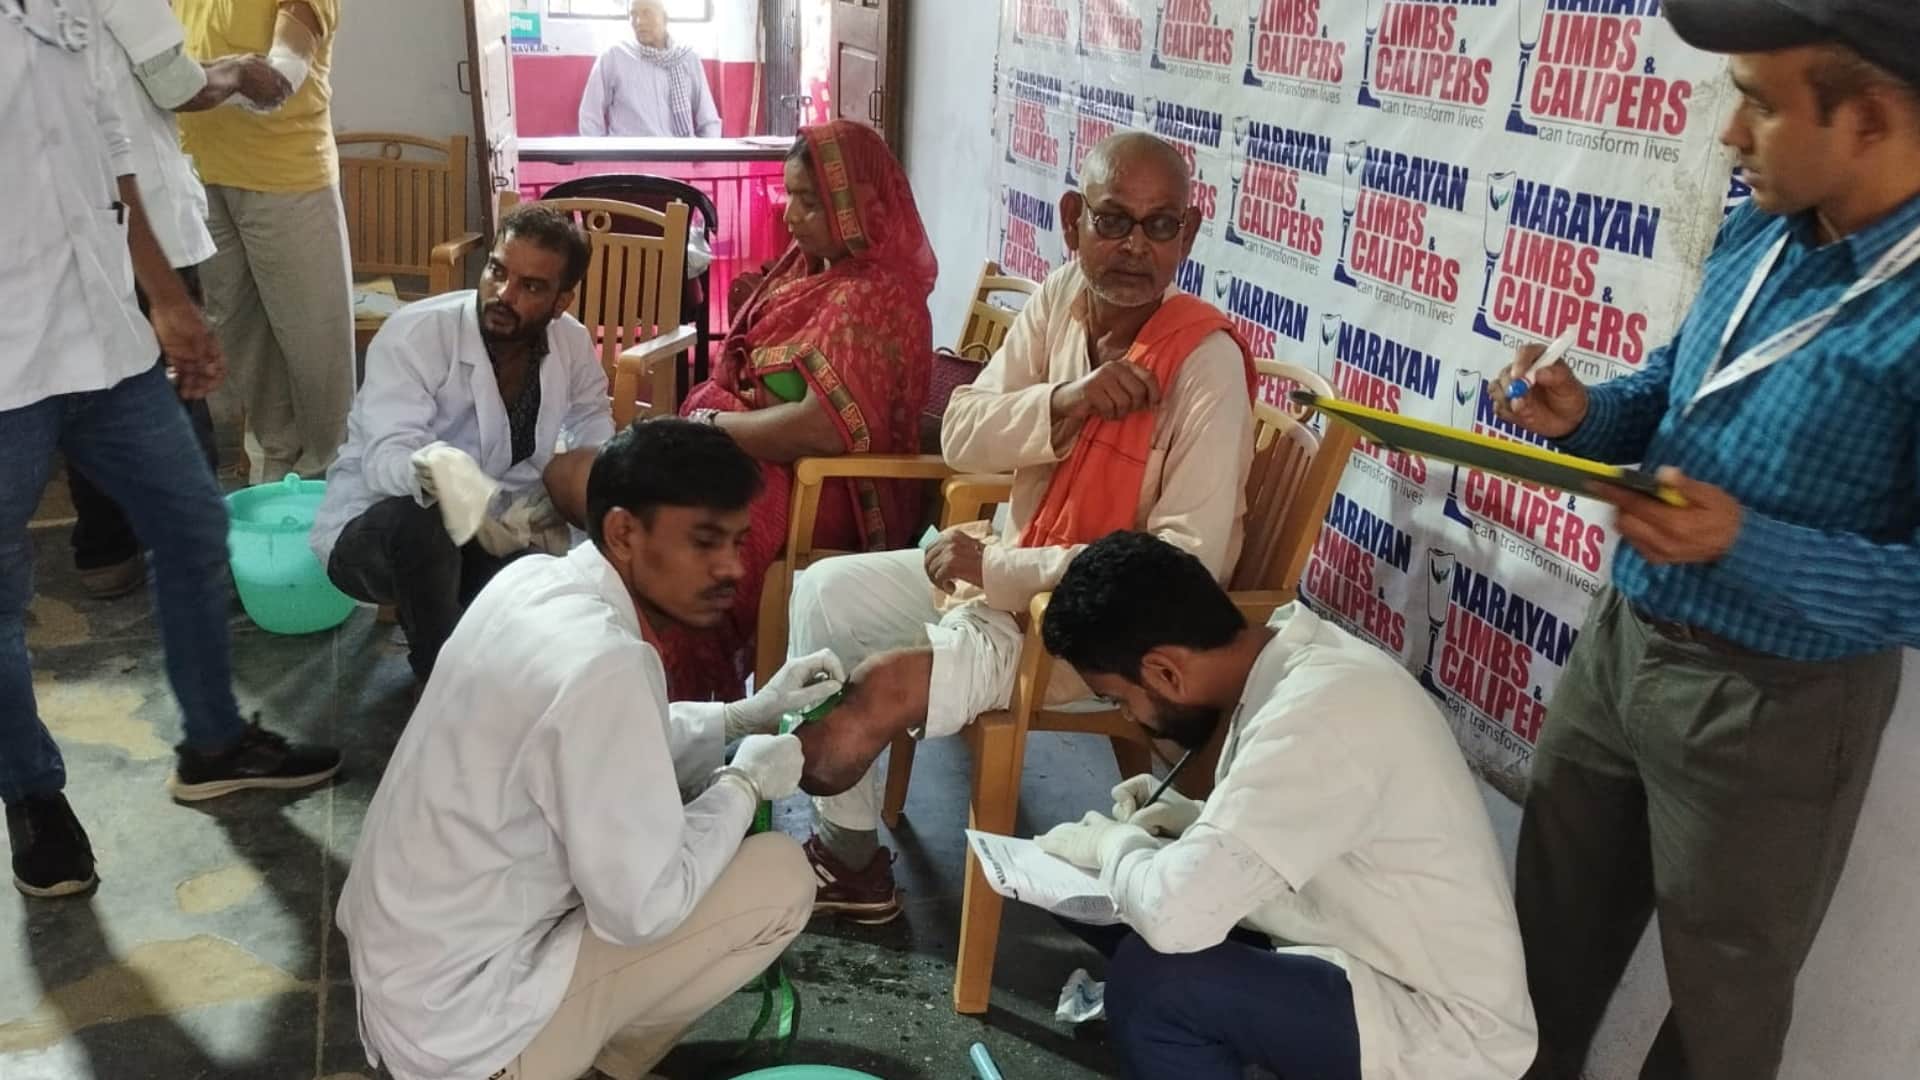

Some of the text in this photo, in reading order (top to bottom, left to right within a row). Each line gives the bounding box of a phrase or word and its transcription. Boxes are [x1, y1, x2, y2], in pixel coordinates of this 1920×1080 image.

[1162, 23, 1235, 65] CALIPERS
[1259, 0, 1320, 37] LIMBS
[1378, 2, 1457, 53] LIMBS
[1538, 13, 1655, 74] LIMBS &
[1257, 33, 1346, 83] CALIPERS
[1375, 47, 1492, 106] CALIPERS
[1381, 100, 1484, 129] can transform lives
[1530, 65, 1692, 136] CALIPERS
[1246, 121, 1331, 176] NARAYAN
[1538, 125, 1680, 164] can transform lives
[1242, 158, 1299, 209] LIMBS
[1361, 146, 1468, 212] NARAYAN
[1238, 196, 1325, 257] CALIPERS
[1355, 188, 1427, 247] LIMBS
[1510, 178, 1661, 259] NARAYAN
[1260, 242, 1299, 267] transform
[1300, 254, 1320, 276] lives
[1351, 230, 1460, 303] CALIPERS
[1502, 227, 1614, 304] LIMBS &
[1227, 276, 1308, 342] NARAYAN
[1356, 279, 1455, 325] can transform lives
[1493, 275, 1648, 365] CALIPERS
[1336, 321, 1440, 400] NARAYAN
[1400, 482, 1424, 505] lives
[1465, 468, 1605, 573] CALIPERS
[1473, 521, 1598, 595] can transform lives
[1306, 558, 1406, 653] CALIPERS
[1451, 561, 1579, 667] NARAYAN
[1445, 603, 1532, 689] LIMBS
[1439, 644, 1547, 745] CALIPER
[1447, 696, 1467, 720] can
